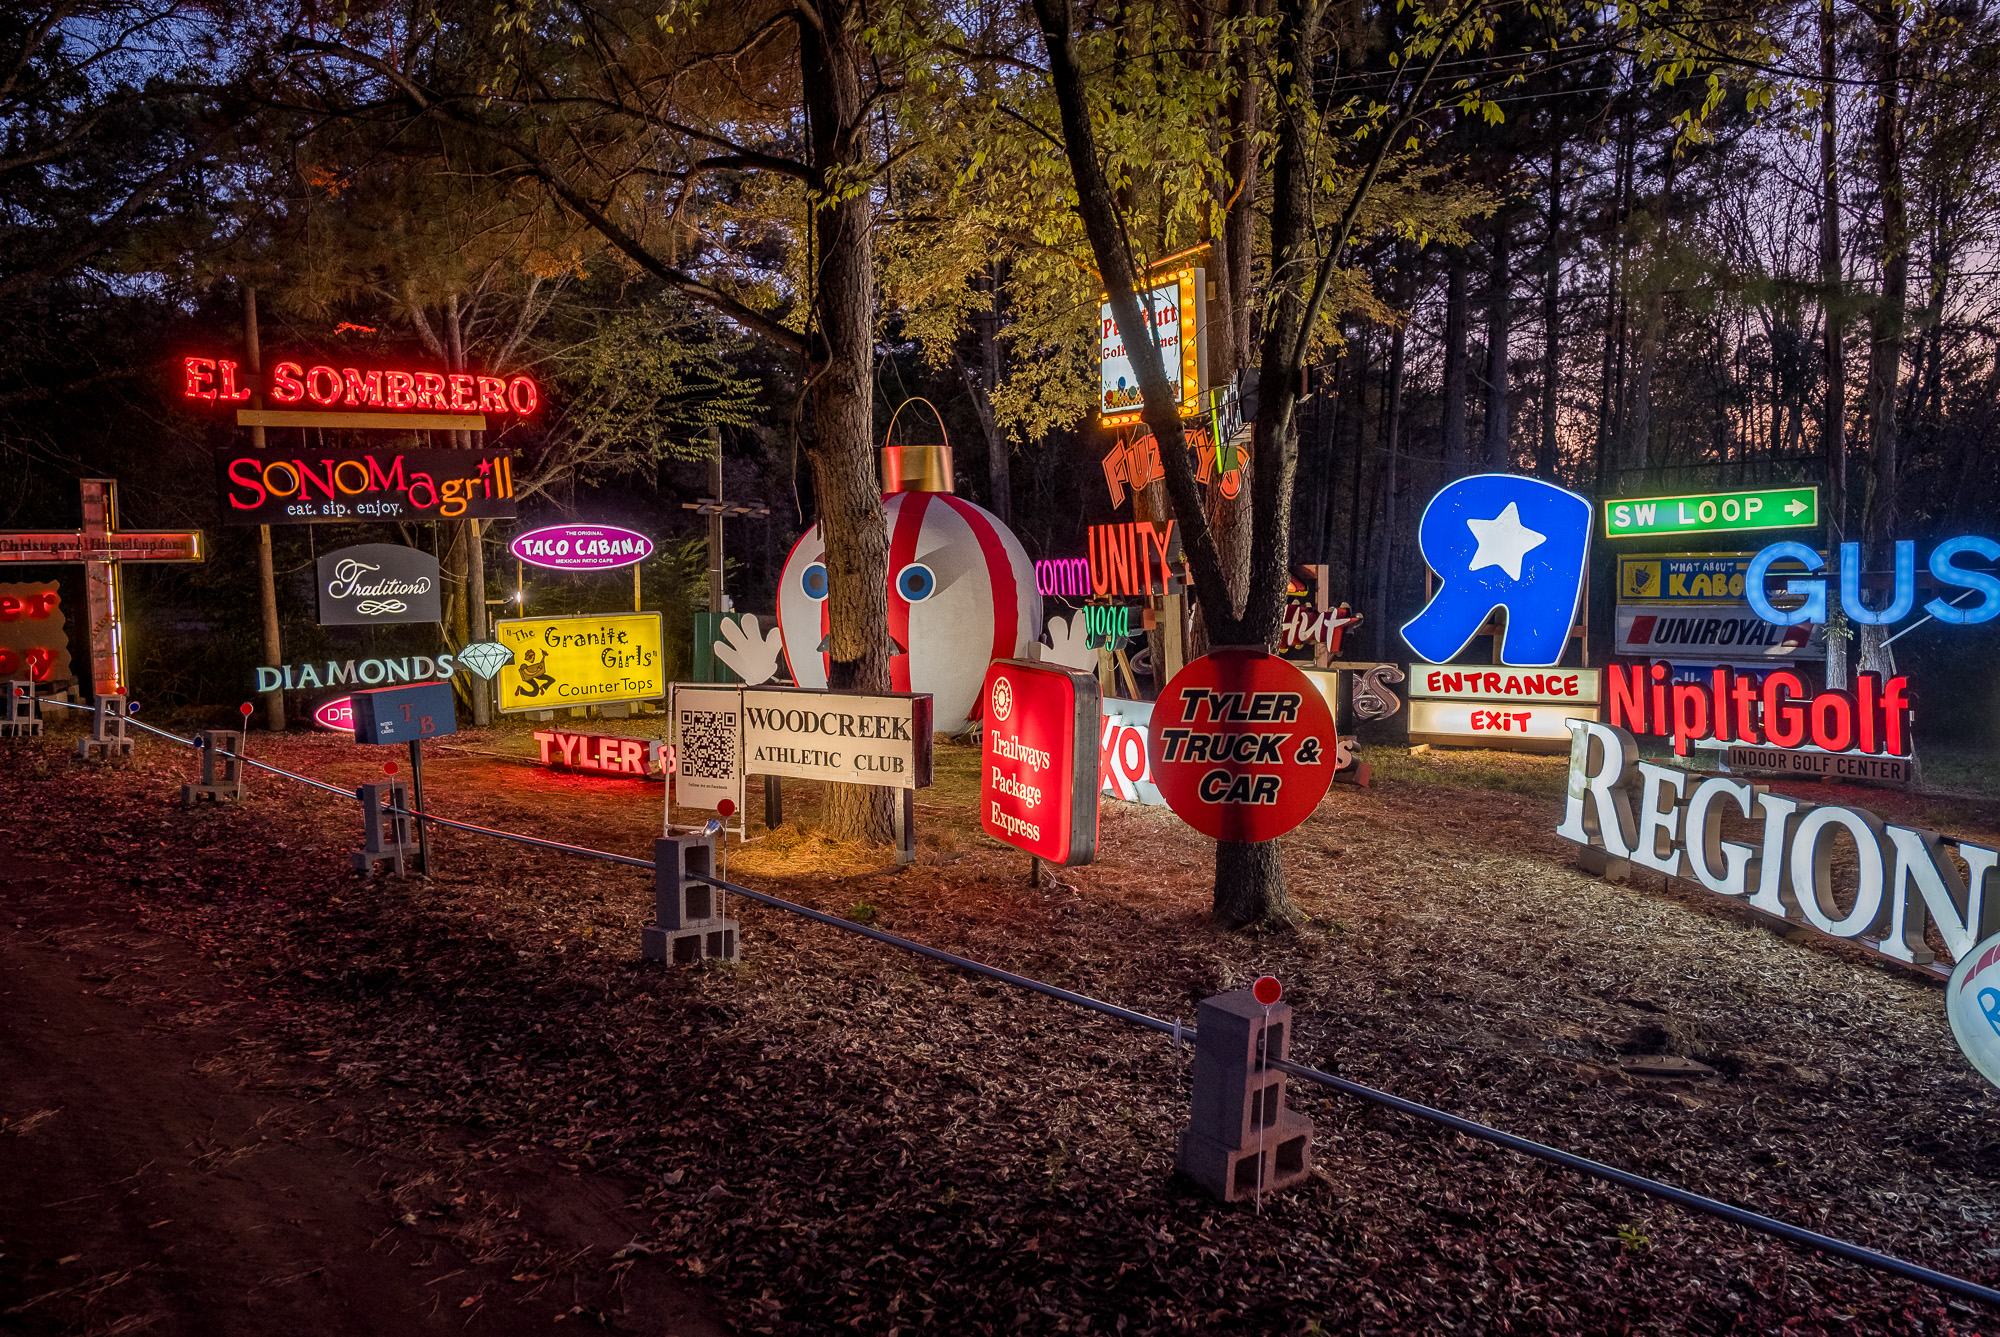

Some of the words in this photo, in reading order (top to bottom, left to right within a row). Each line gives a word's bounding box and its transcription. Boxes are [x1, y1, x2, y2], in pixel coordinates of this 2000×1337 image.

[184, 357, 251, 401] EL
[272, 361, 538, 415] SOMBRERO
[287, 504, 317, 516] eat.
[322, 501, 351, 517] sip.
[357, 501, 403, 517] enjoy.
[1614, 504, 1657, 528] SW
[1678, 498, 1763, 524] LOOP
[521, 539, 570, 556] TACO
[575, 538, 645, 556] CABANA
[328, 558, 431, 599] Traditions
[1669, 573, 1747, 597] KABO
[1670, 562, 1700, 572] WHAT
[1745, 535, 2000, 626] GUS
[545, 627, 629, 648] Granite
[1082, 605, 1129, 651] yoga
[1654, 618, 1778, 645] UNIROYAL
[256, 655, 454, 692] DIAMONDS
[1427, 671, 1579, 697] ENTRANCE
[1179, 687, 1303, 723] TYLER
[746, 707, 912, 741] WOODCREEK
[534, 731, 645, 774] TYLER
[754, 745, 842, 768] ATHLETIC
[854, 754, 905, 773] CLUB
[991, 729, 1050, 772] Trailways
[1160, 727, 1293, 764] TRUCK
[1294, 736, 1323, 765] &
[1732, 749, 1787, 769] INDOOR
[1793, 755, 1831, 773] GOLF
[1837, 758, 1900, 780] CENTER
[991, 766, 1042, 809] Package
[1197, 768, 1282, 805] CAR
[991, 801, 1041, 842] Express
[1557, 718, 1999, 964] REGION
